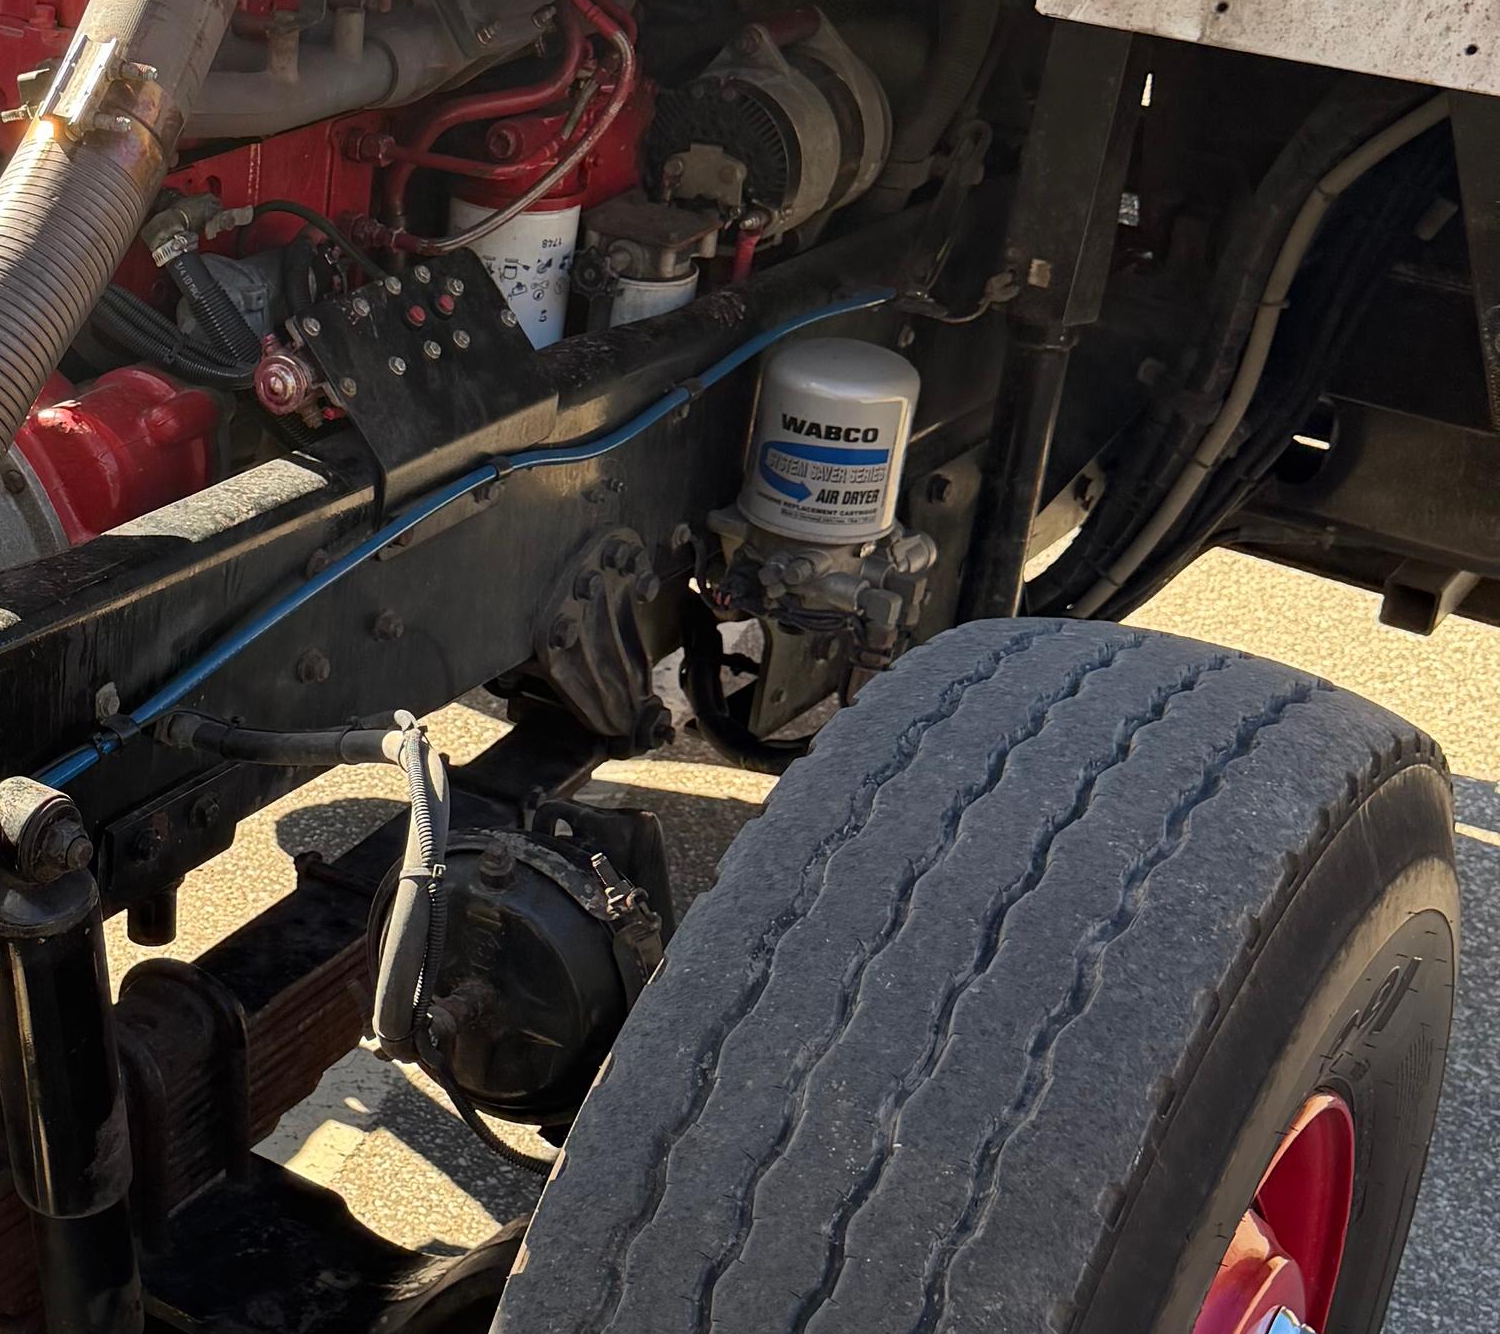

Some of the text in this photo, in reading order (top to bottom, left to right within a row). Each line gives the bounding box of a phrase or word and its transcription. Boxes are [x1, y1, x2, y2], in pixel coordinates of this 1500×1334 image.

[782, 413, 878, 443] WABCO
[811, 464, 847, 483] SAVER
[850, 467, 886, 483] SERIES
[816, 489, 879, 504] AIR DRYER
[783, 500, 837, 515] REPLACEMENT
